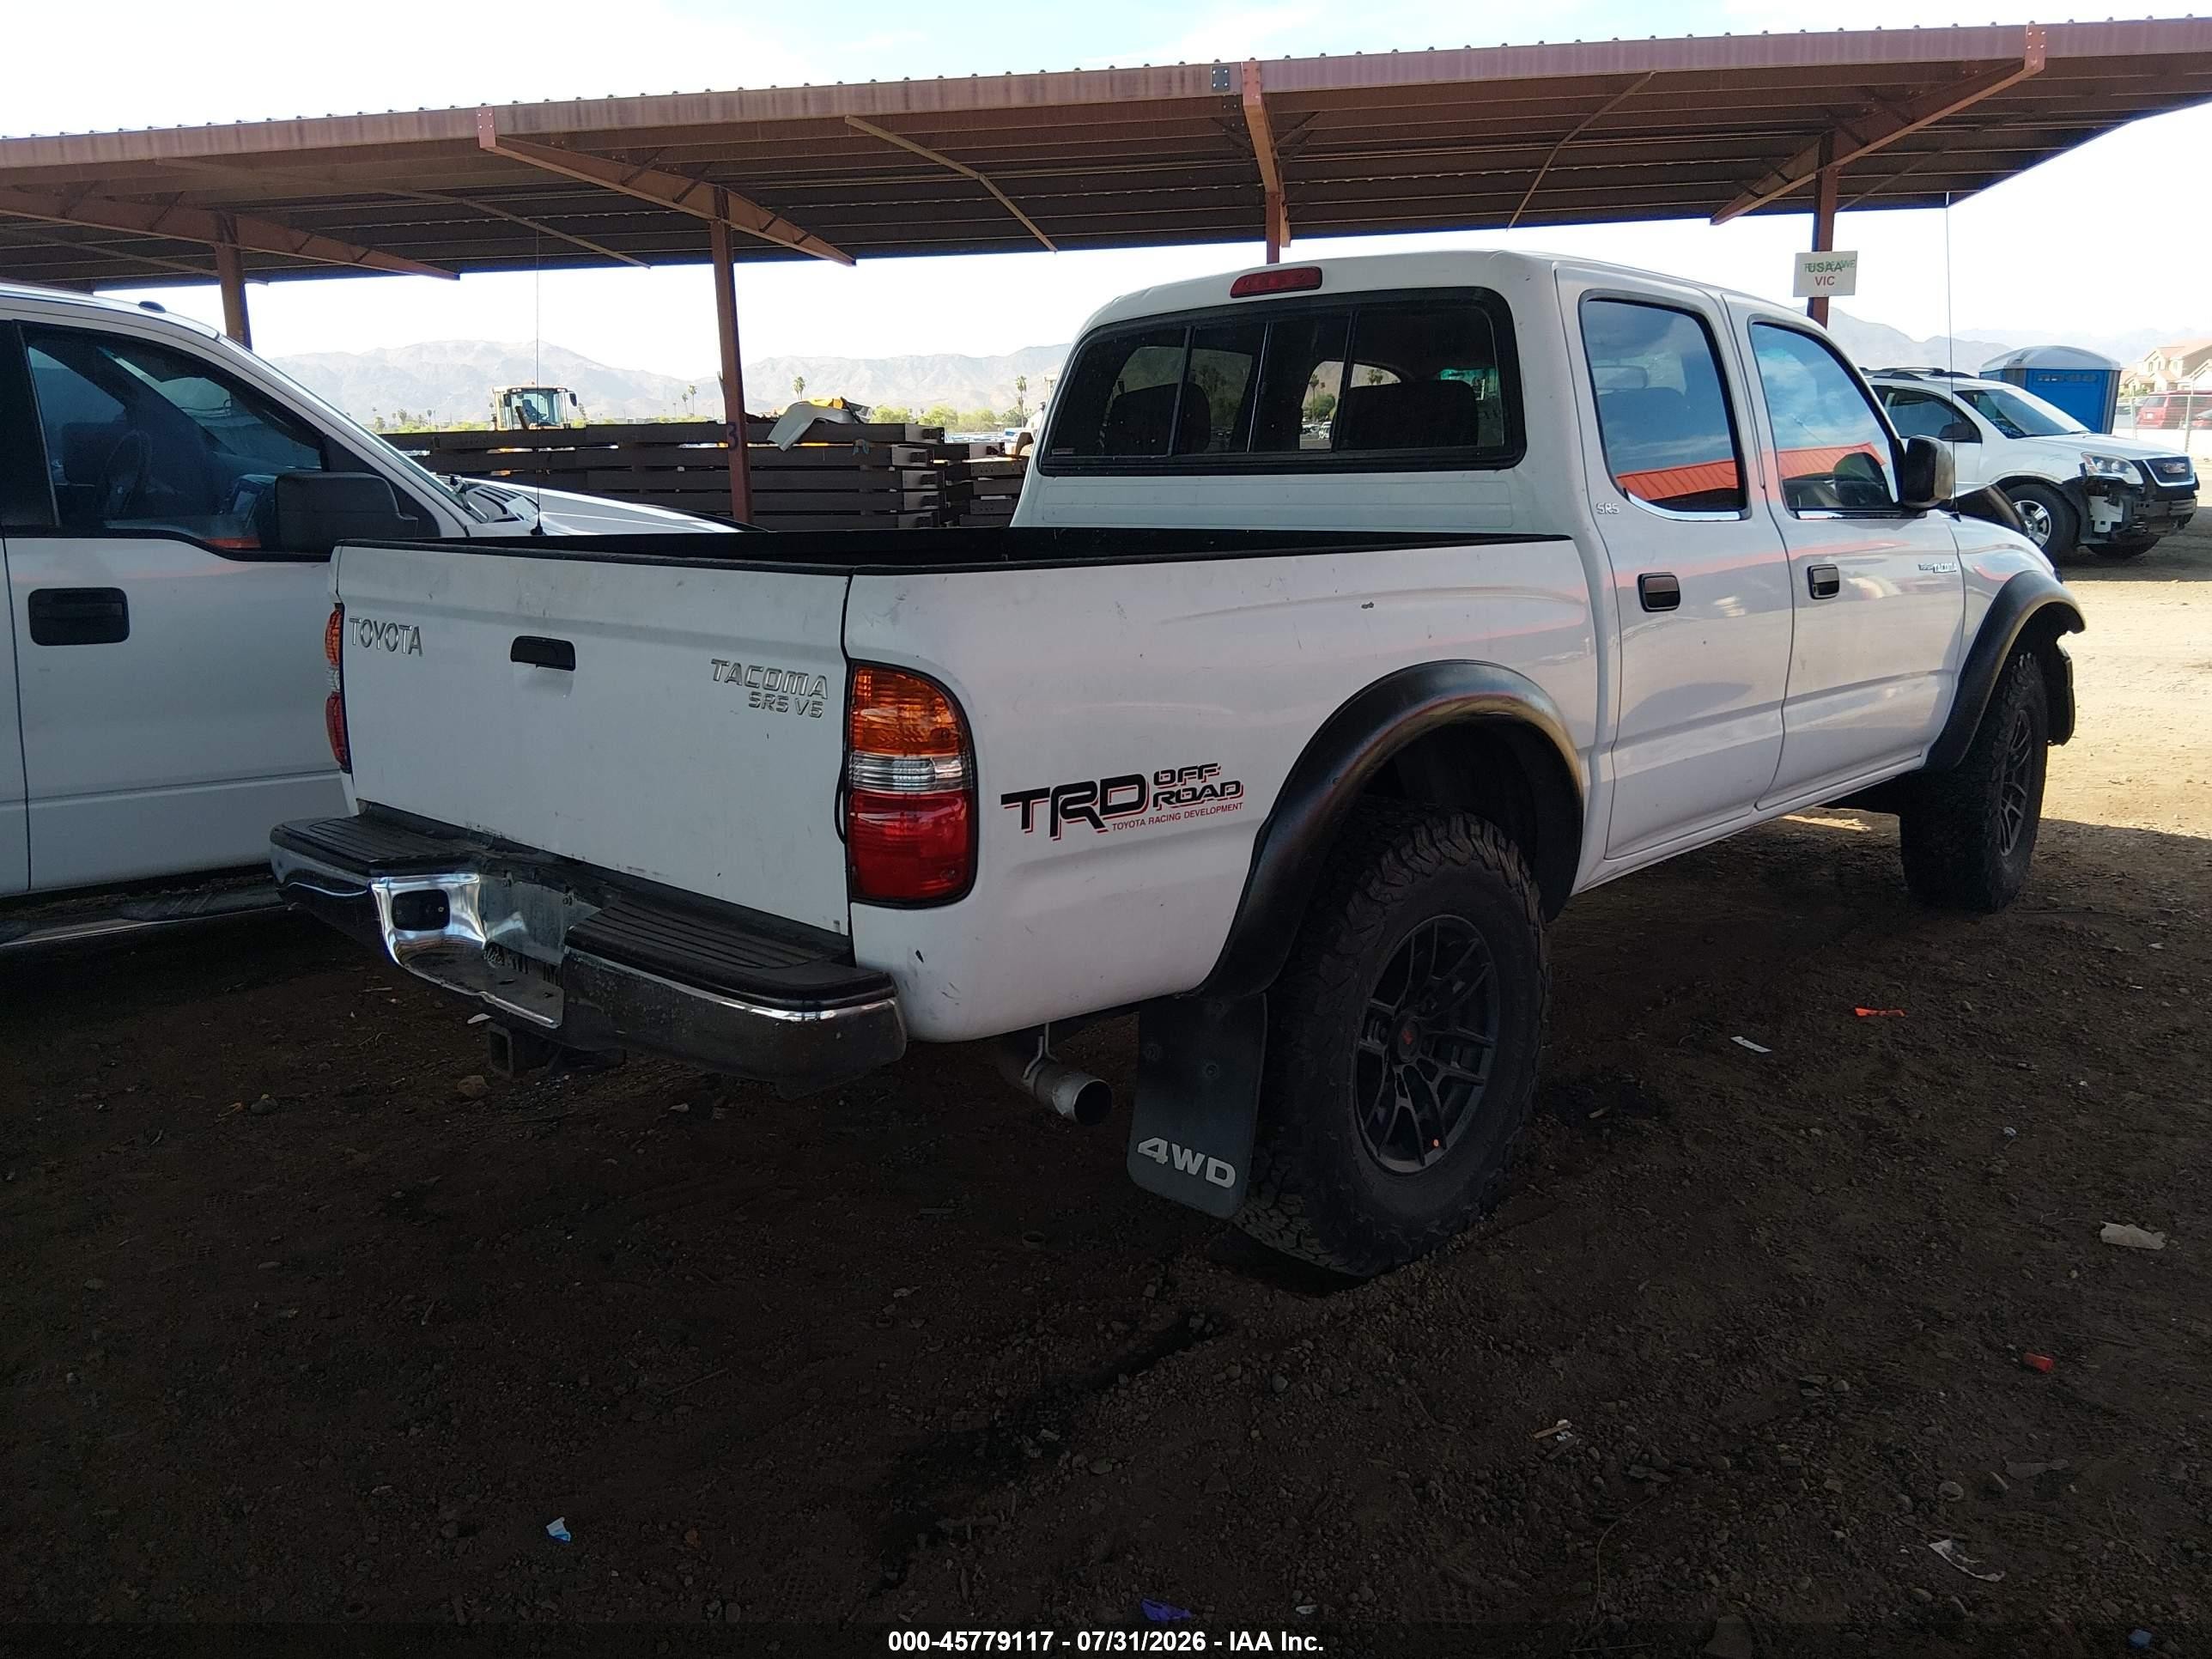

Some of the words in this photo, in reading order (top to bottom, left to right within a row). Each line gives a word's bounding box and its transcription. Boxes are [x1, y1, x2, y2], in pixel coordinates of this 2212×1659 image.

[1808, 261, 1843, 273] USAA
[1814, 276, 1835, 286] VIC
[349, 617, 423, 657] TOYOTA
[711, 658, 829, 700] TACOMA
[748, 690, 789, 713] SR5
[794, 697, 824, 718] V6
[1153, 763, 1221, 788] OFF
[1000, 773, 1150, 841] TRD
[1152, 780, 1244, 811] ROAD
[1111, 818, 1146, 832] TOYOTA
[1148, 811, 1182, 826] RACING
[1183, 802, 1244, 820] DEVELOPMENT
[1137, 1137, 1237, 1188] 4WD
